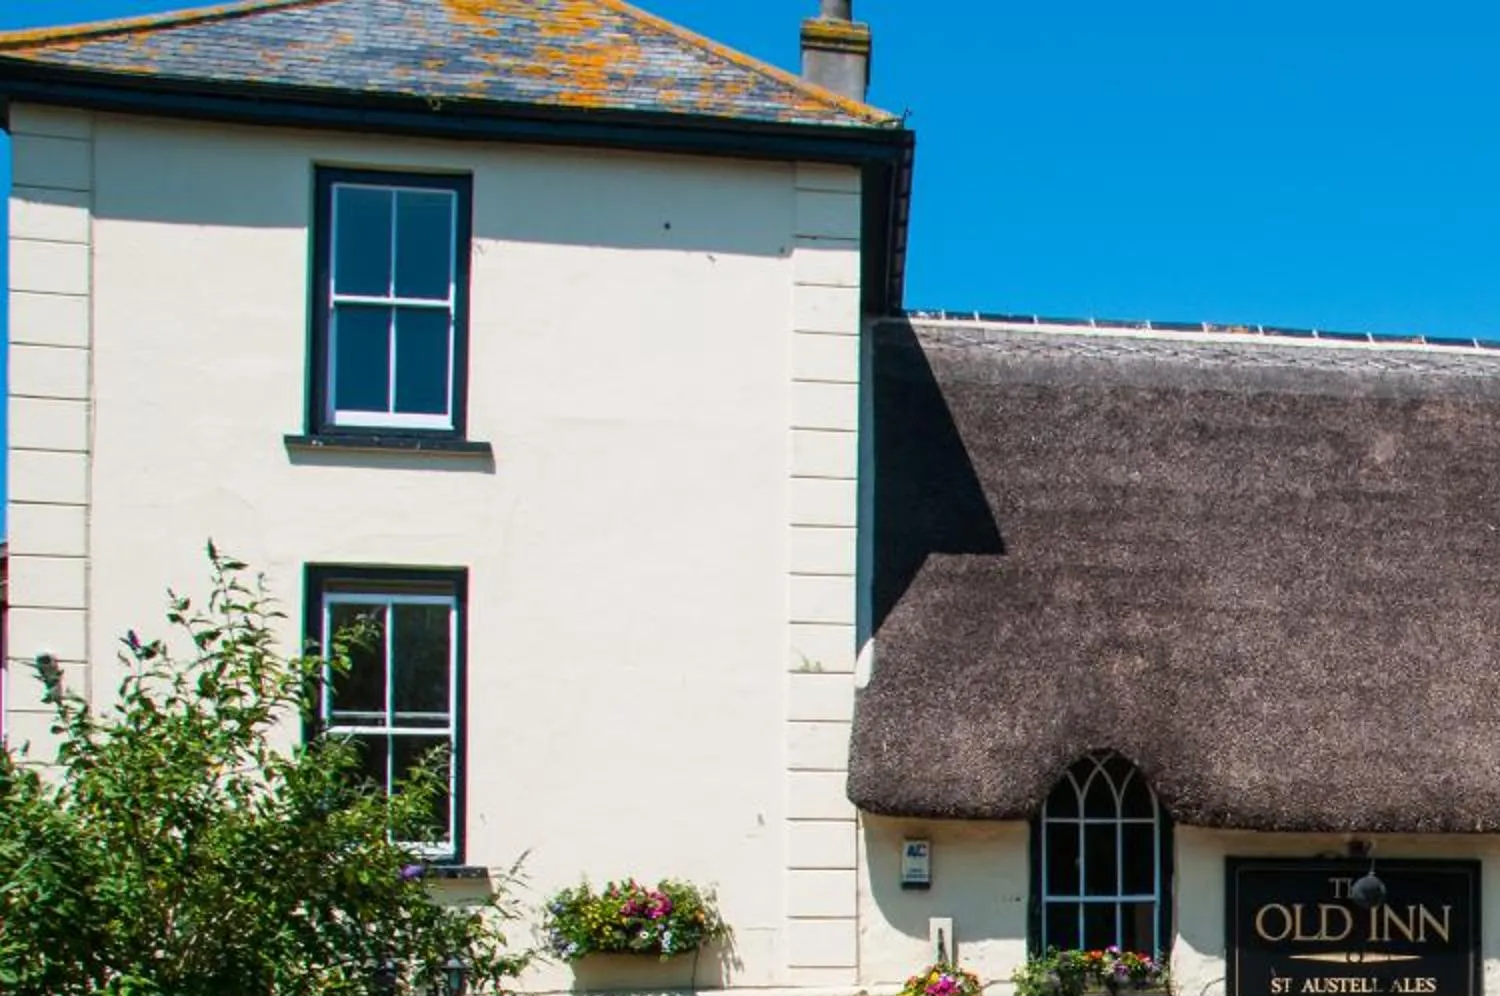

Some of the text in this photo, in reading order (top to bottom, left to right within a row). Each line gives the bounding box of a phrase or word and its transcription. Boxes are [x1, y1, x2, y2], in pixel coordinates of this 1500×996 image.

[1255, 903, 1452, 943] OLD INN
[1271, 977, 1437, 994] ST AUSTELL ALES
